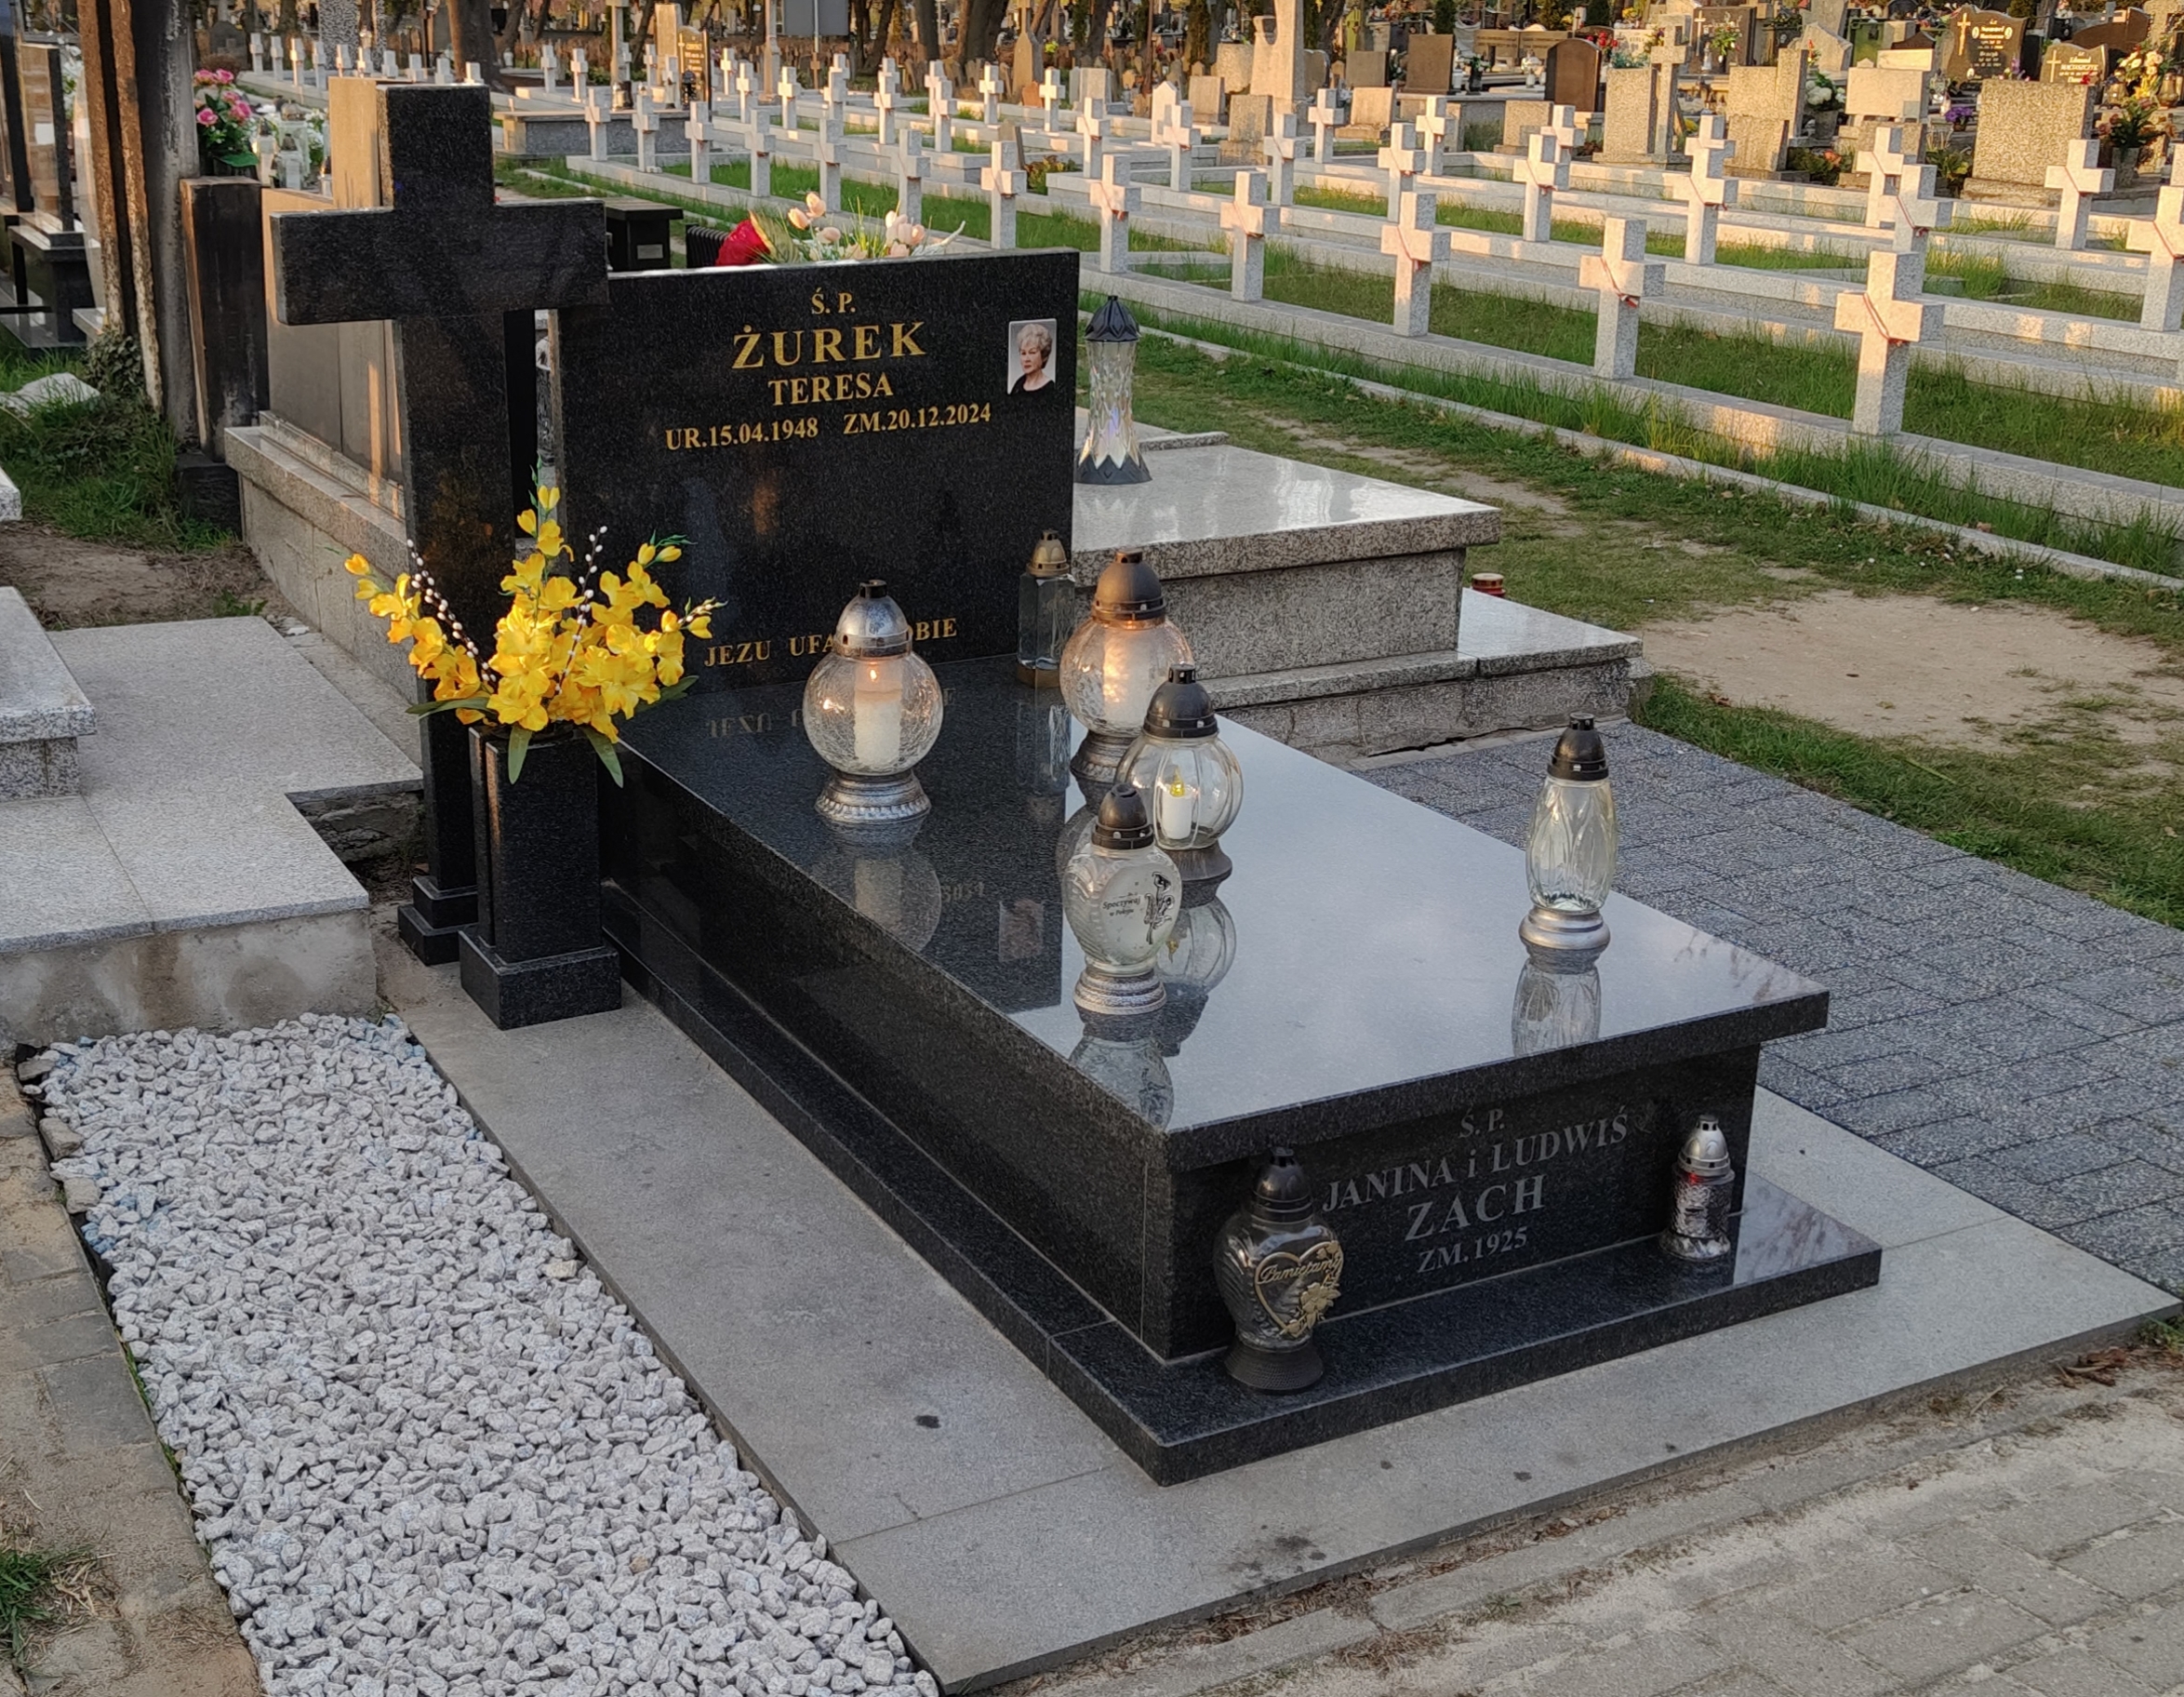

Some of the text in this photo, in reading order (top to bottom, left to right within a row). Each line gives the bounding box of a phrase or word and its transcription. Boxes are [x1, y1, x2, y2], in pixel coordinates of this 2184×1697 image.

[811, 287, 857, 314] Ś. P.
[731, 321, 927, 369] ŻUREK
[767, 371, 894, 407] TERESA
[664, 402, 992, 450] UR.15.04.1948 ZM.20.12.2024
[704, 617, 958, 668] JEZU UFA BIE
[1458, 1107, 1506, 1140] Ś. P.
[1322, 1104, 1629, 1212] JANINA i LUDWIŚ
[1405, 1174, 1548, 1242] ZACH
